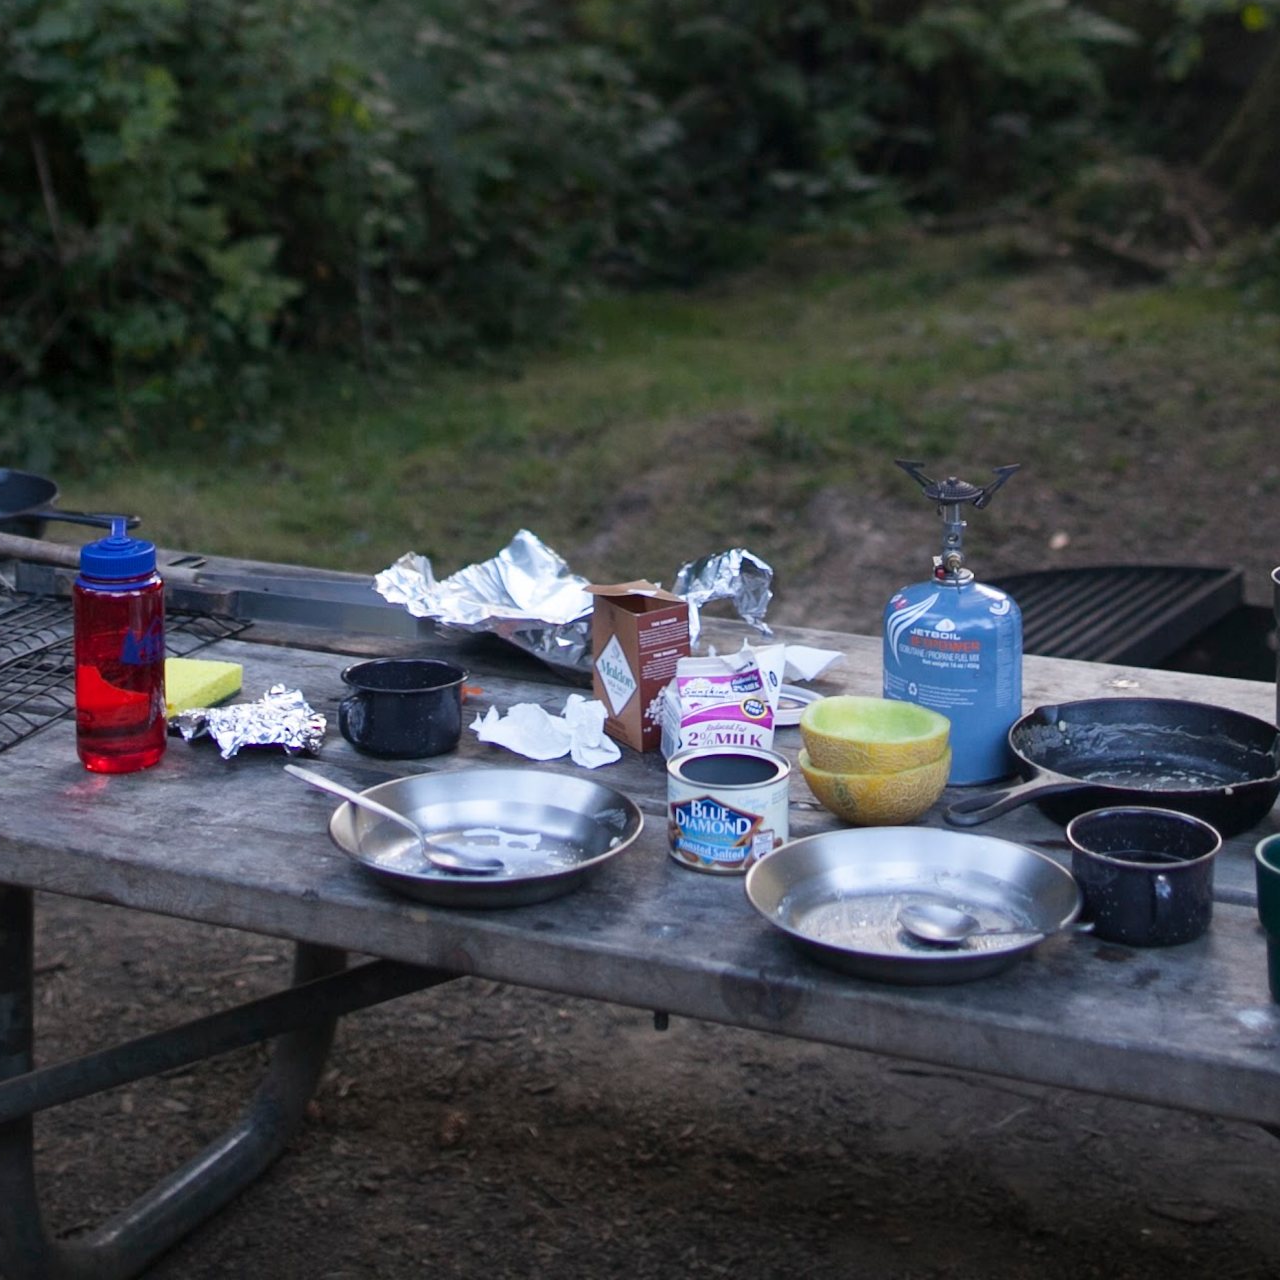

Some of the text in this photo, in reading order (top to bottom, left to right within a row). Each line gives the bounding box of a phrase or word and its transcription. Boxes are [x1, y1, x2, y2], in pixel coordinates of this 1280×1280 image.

[910, 628, 961, 640] JETBOIL
[600, 659, 634, 689] Maldon
[684, 687, 729, 695] Sunshine
[691, 800, 730, 822] BLUE
[675, 807, 752, 835] DIAMOND
[713, 847, 745, 859] Salted
